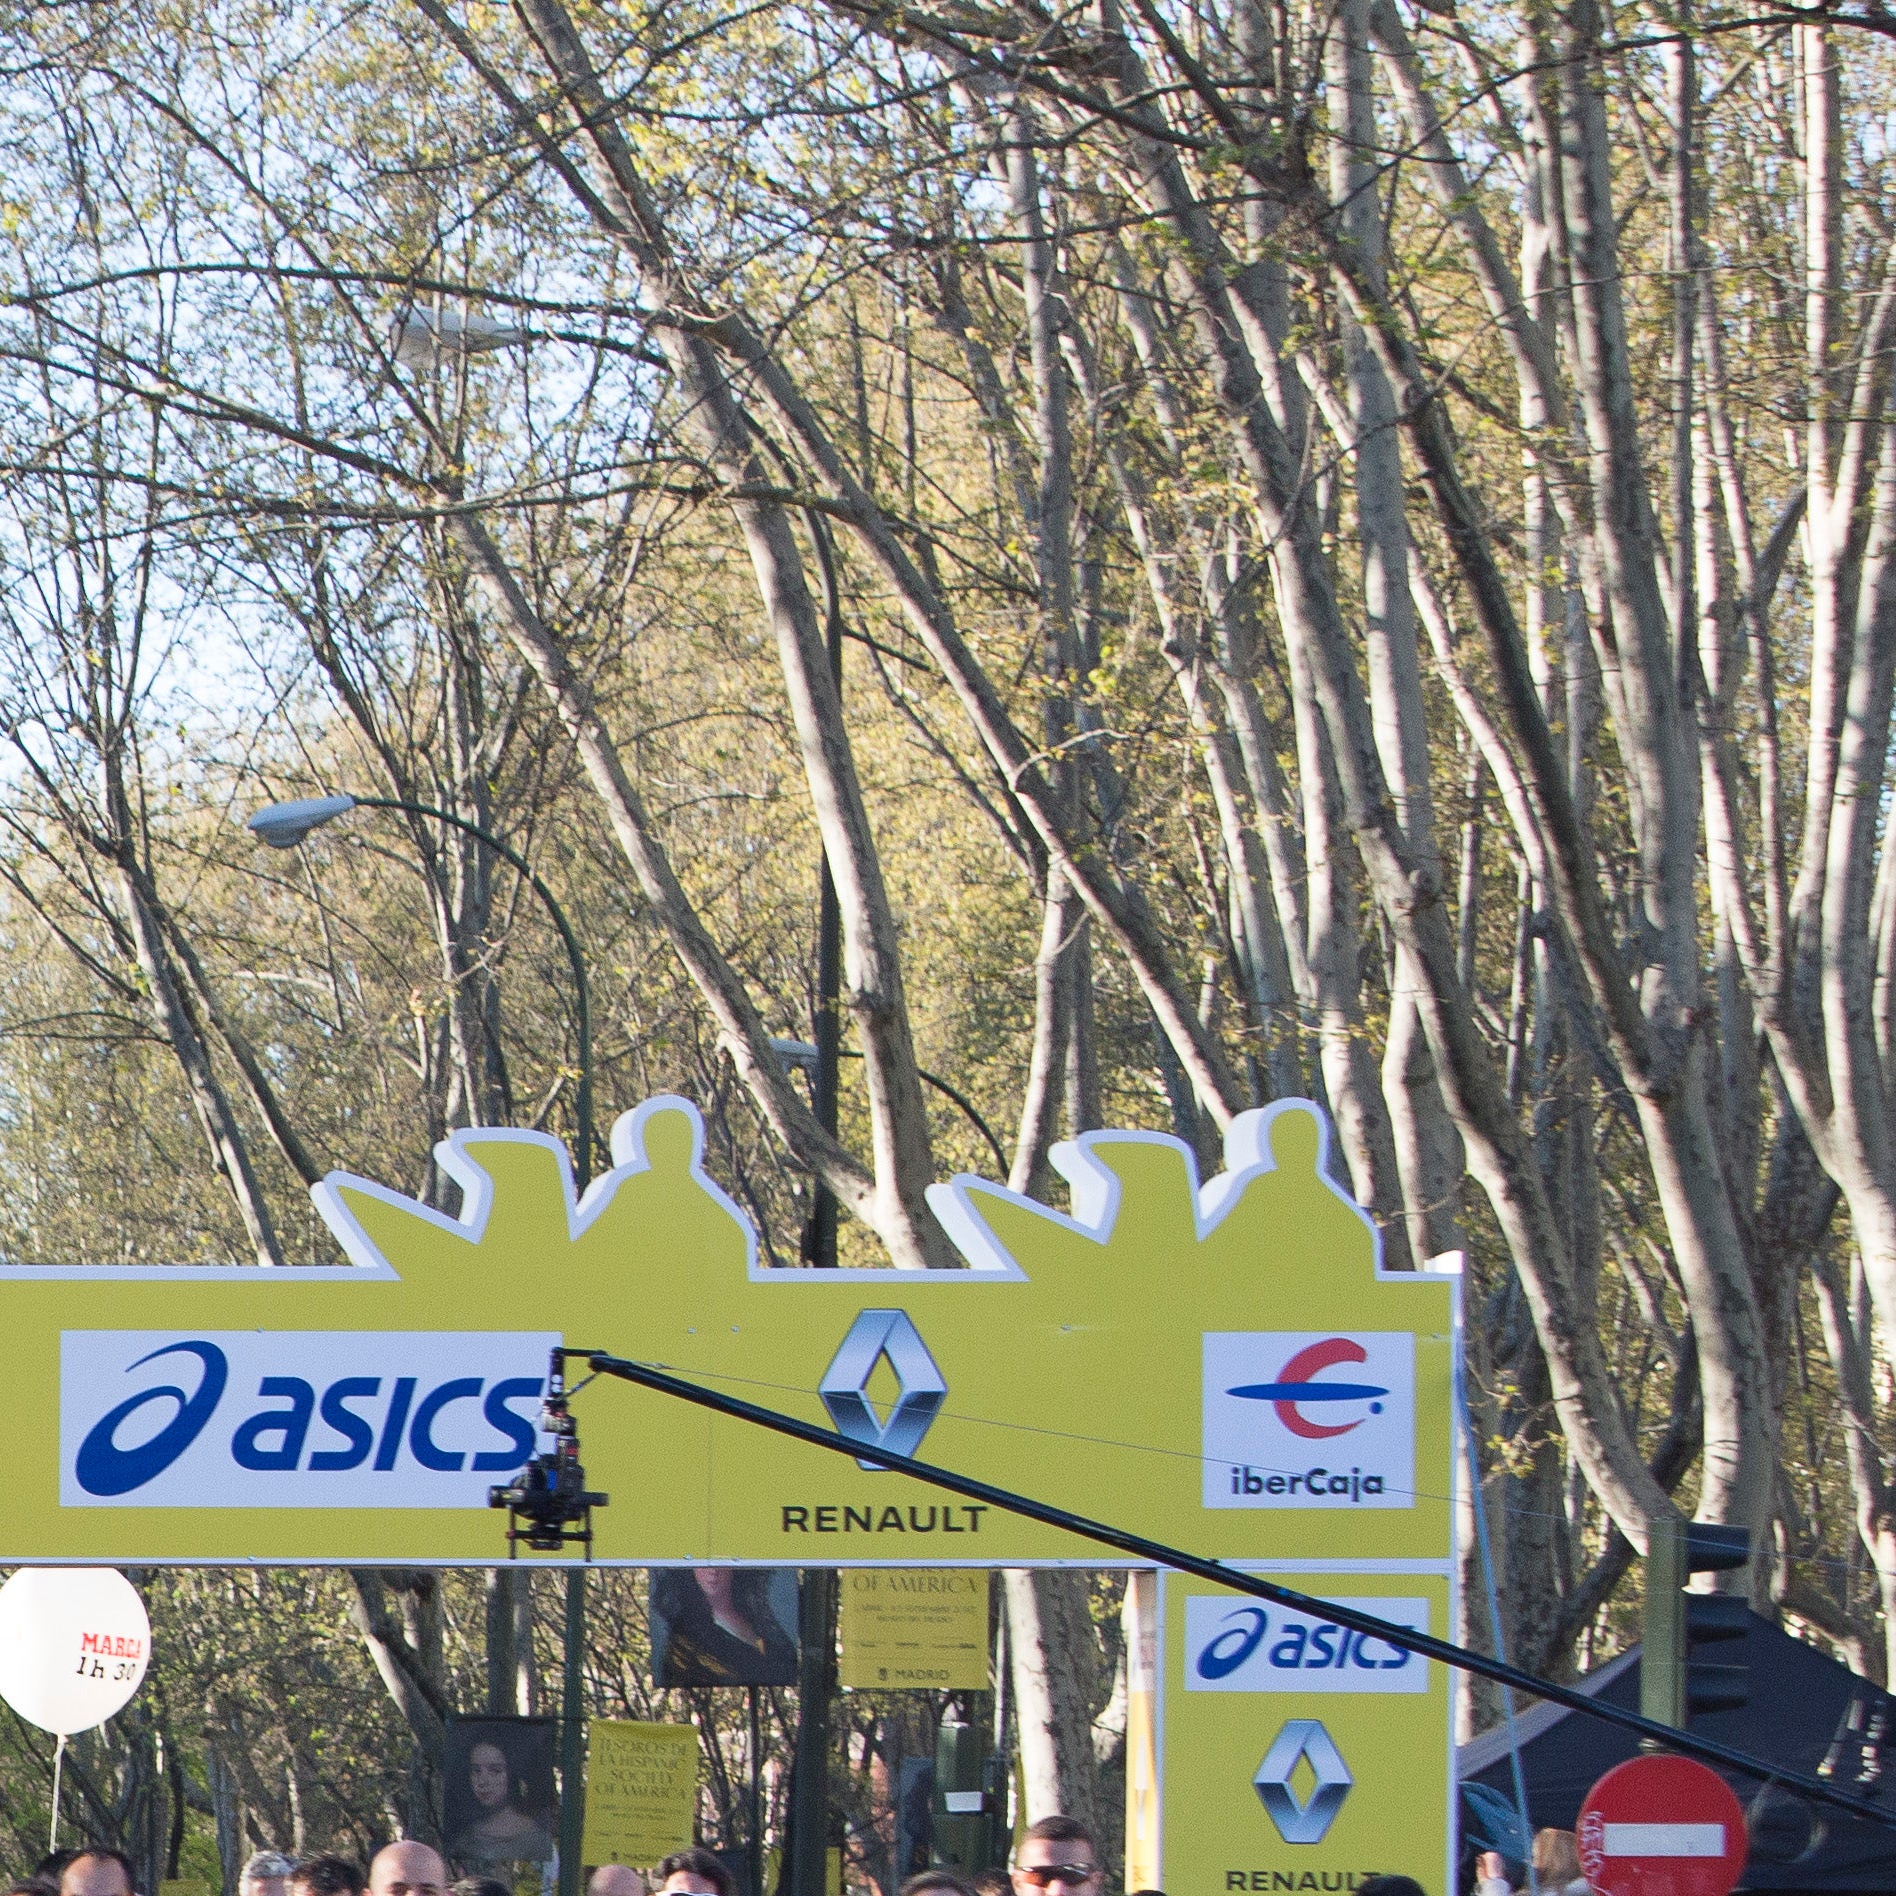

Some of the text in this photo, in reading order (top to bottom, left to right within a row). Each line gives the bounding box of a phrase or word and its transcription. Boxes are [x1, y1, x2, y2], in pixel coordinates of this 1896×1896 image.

[231, 1376, 545, 1472] asics
[1230, 1467, 1384, 1502] iberCaja
[782, 1505, 987, 1533] RENAULT
[82, 1632, 141, 1658] MARCA
